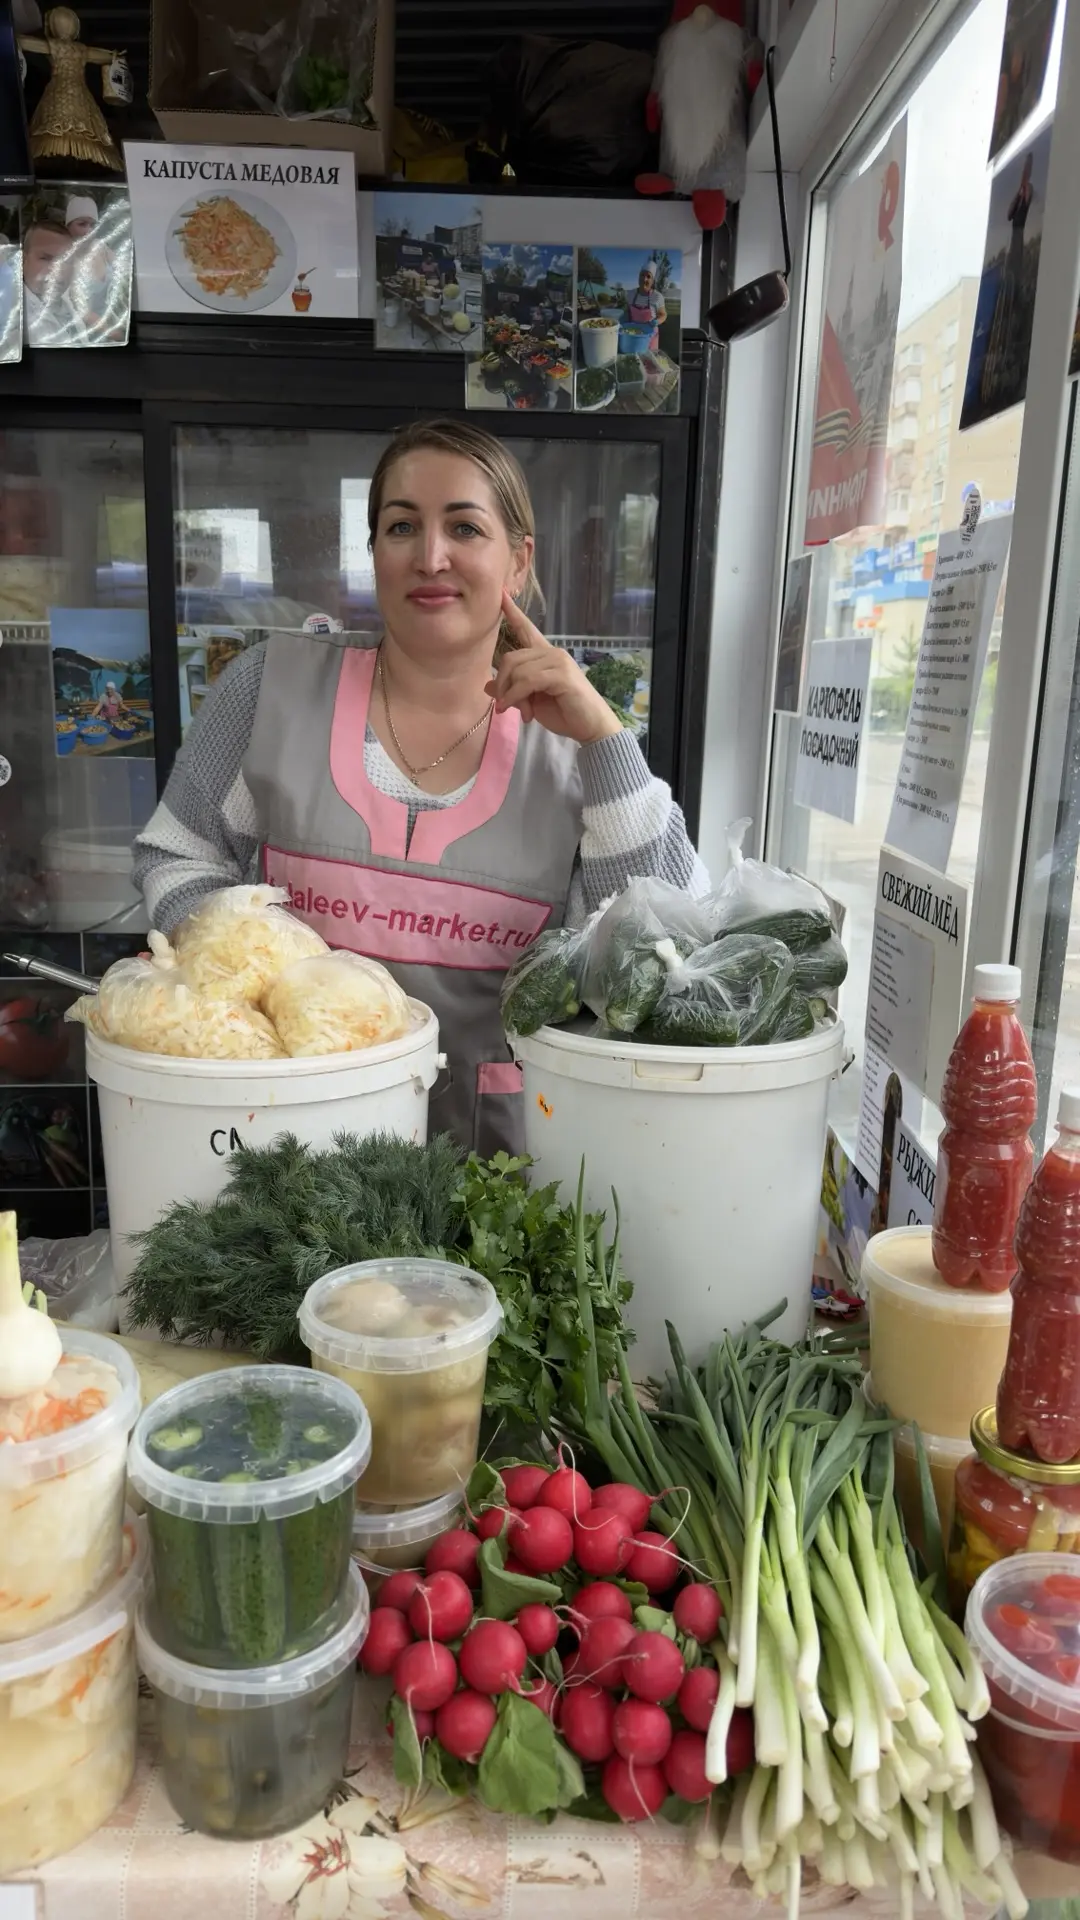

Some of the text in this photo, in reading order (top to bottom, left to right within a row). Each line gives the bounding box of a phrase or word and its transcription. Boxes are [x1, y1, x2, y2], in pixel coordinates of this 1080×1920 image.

[143, 159, 341, 187] КАПУСТА МЕДОВАЯ
[806, 685, 864, 723] КАРТОФЕЛЬ
[800, 729, 859, 768] ПОСАДОЧНЫЙ
[268, 876, 533, 948] aleev-market.ru
[881, 871, 959, 947] СВЕЖИЙ МЁД
[896, 1132, 937, 1208] РЫЖИ
